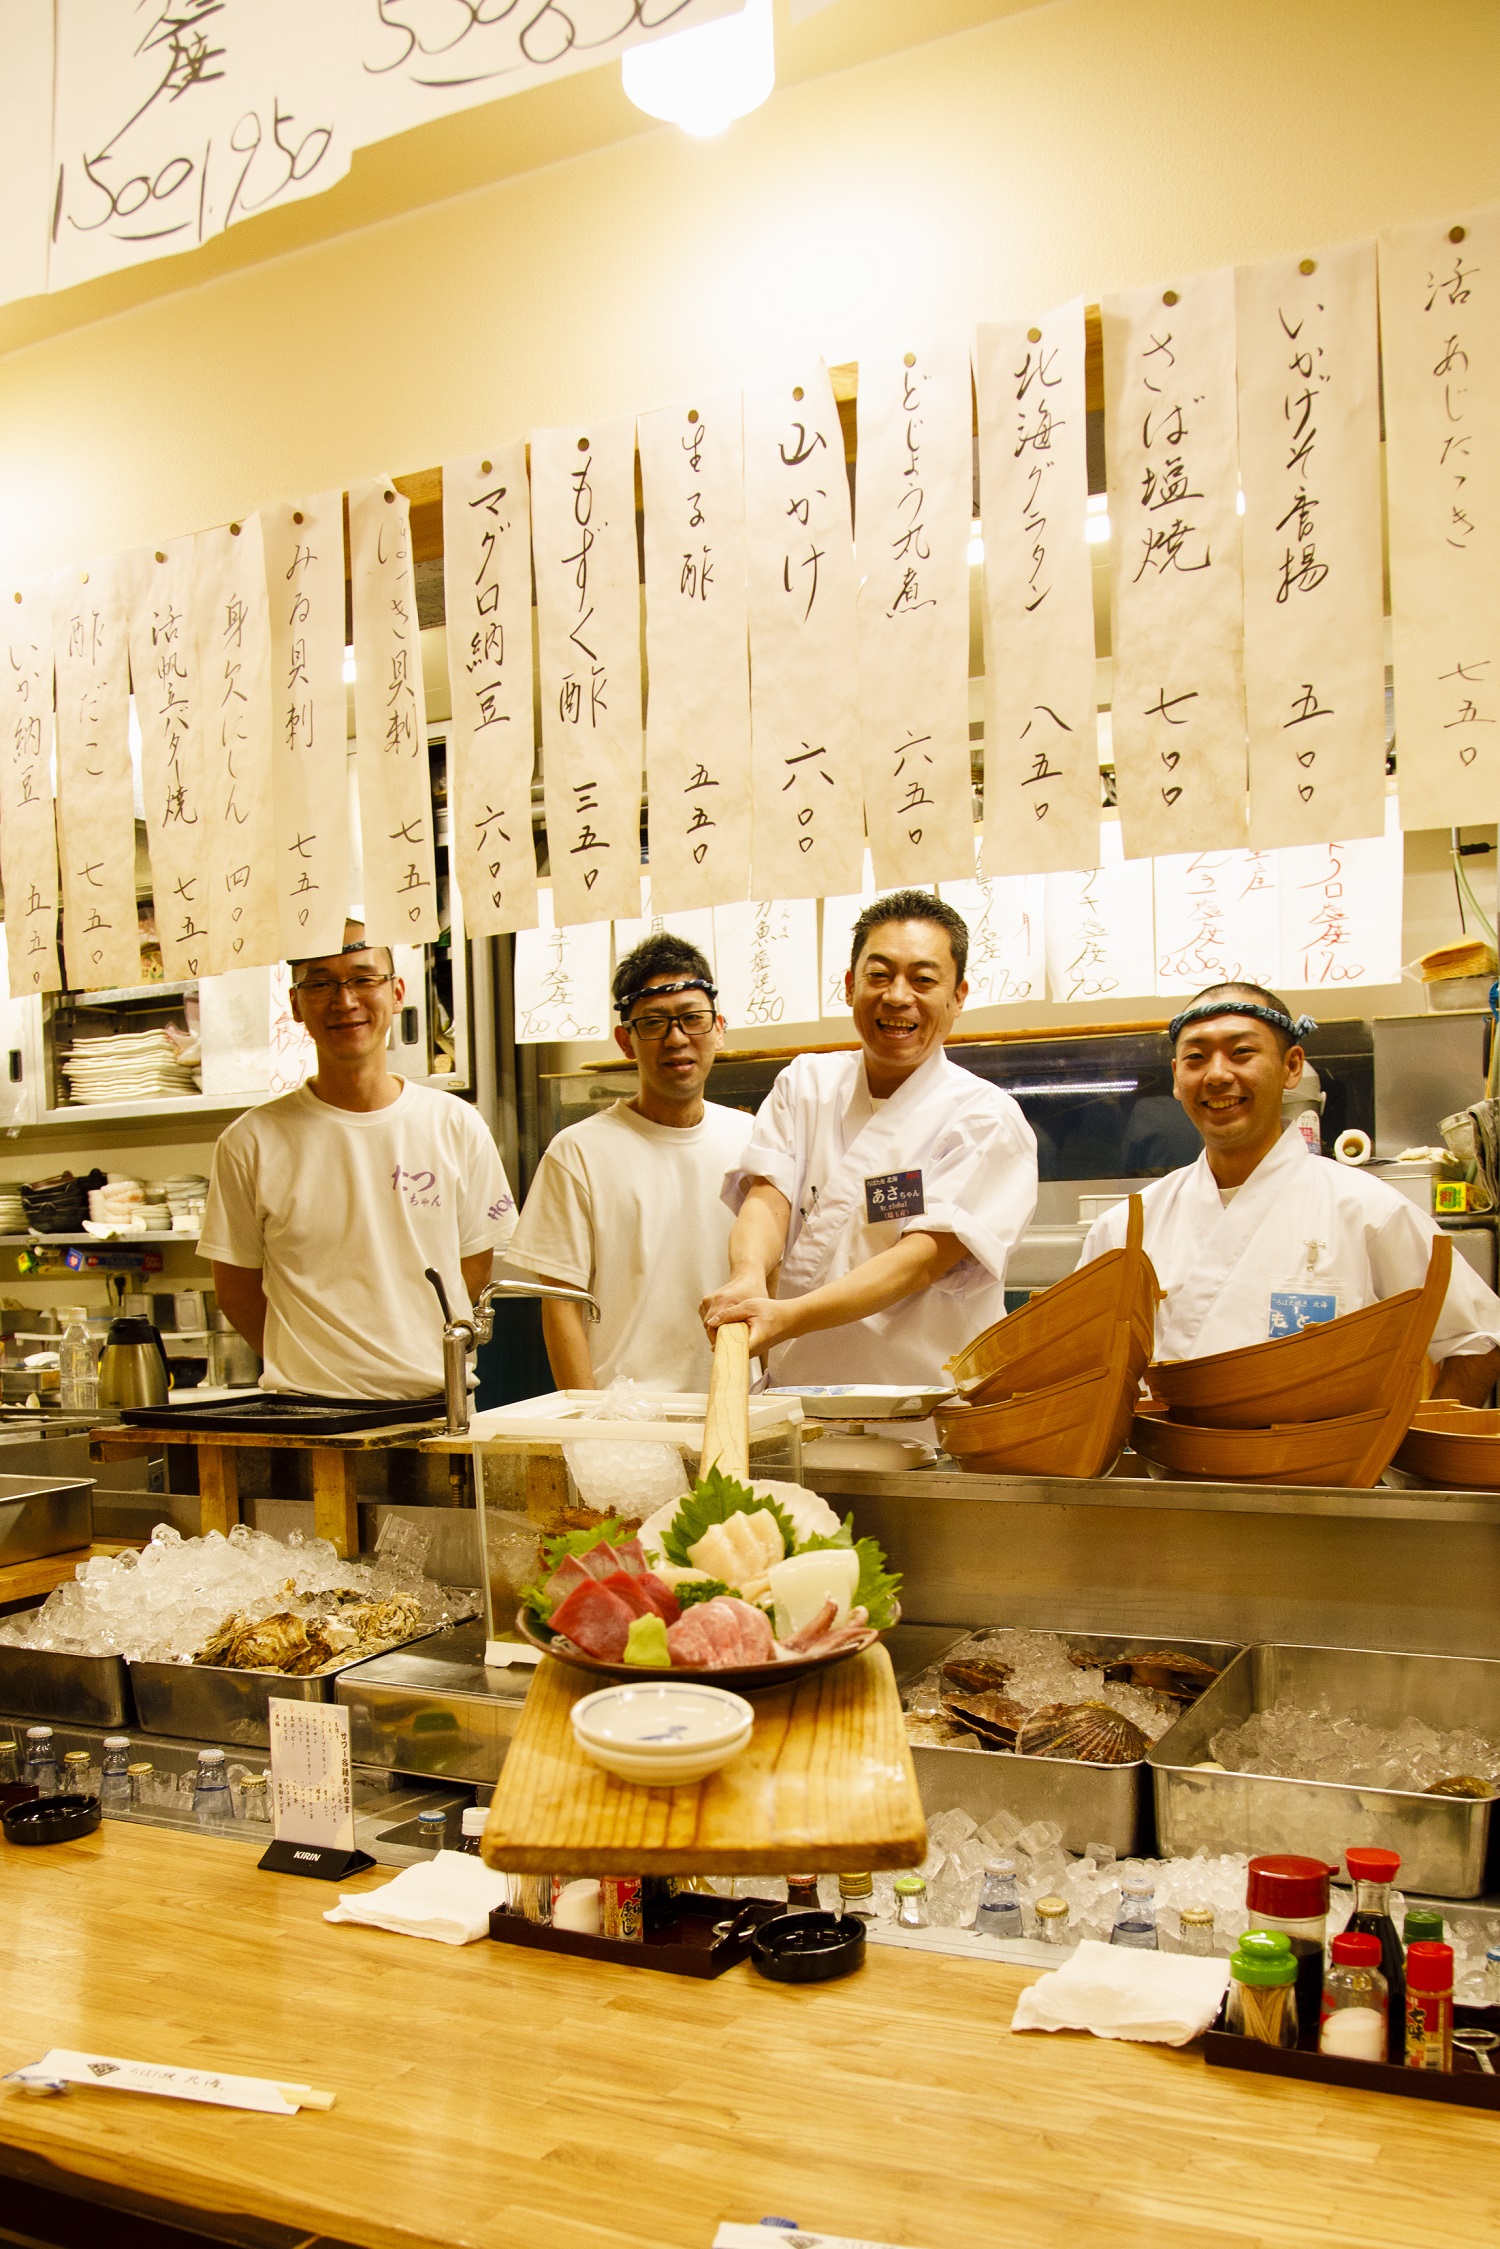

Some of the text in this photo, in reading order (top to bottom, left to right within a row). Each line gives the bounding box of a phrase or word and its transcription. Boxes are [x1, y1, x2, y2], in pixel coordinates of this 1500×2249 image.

[777, 422, 828, 625] 山かけ
[1013, 348, 1066, 612] 北海グラタン
[1132, 333, 1212, 584] さば塩焼
[465, 486, 512, 733] マグロ納豆
[559, 456, 609, 729] もずく酢
[9, 643, 42, 808] いか納豆
[744, 996, 785, 1025] 550
[391, 1164, 436, 1193] たつ
[409, 1193, 442, 1207] ちゃん
[293, 1850, 322, 1862] KIRIN
